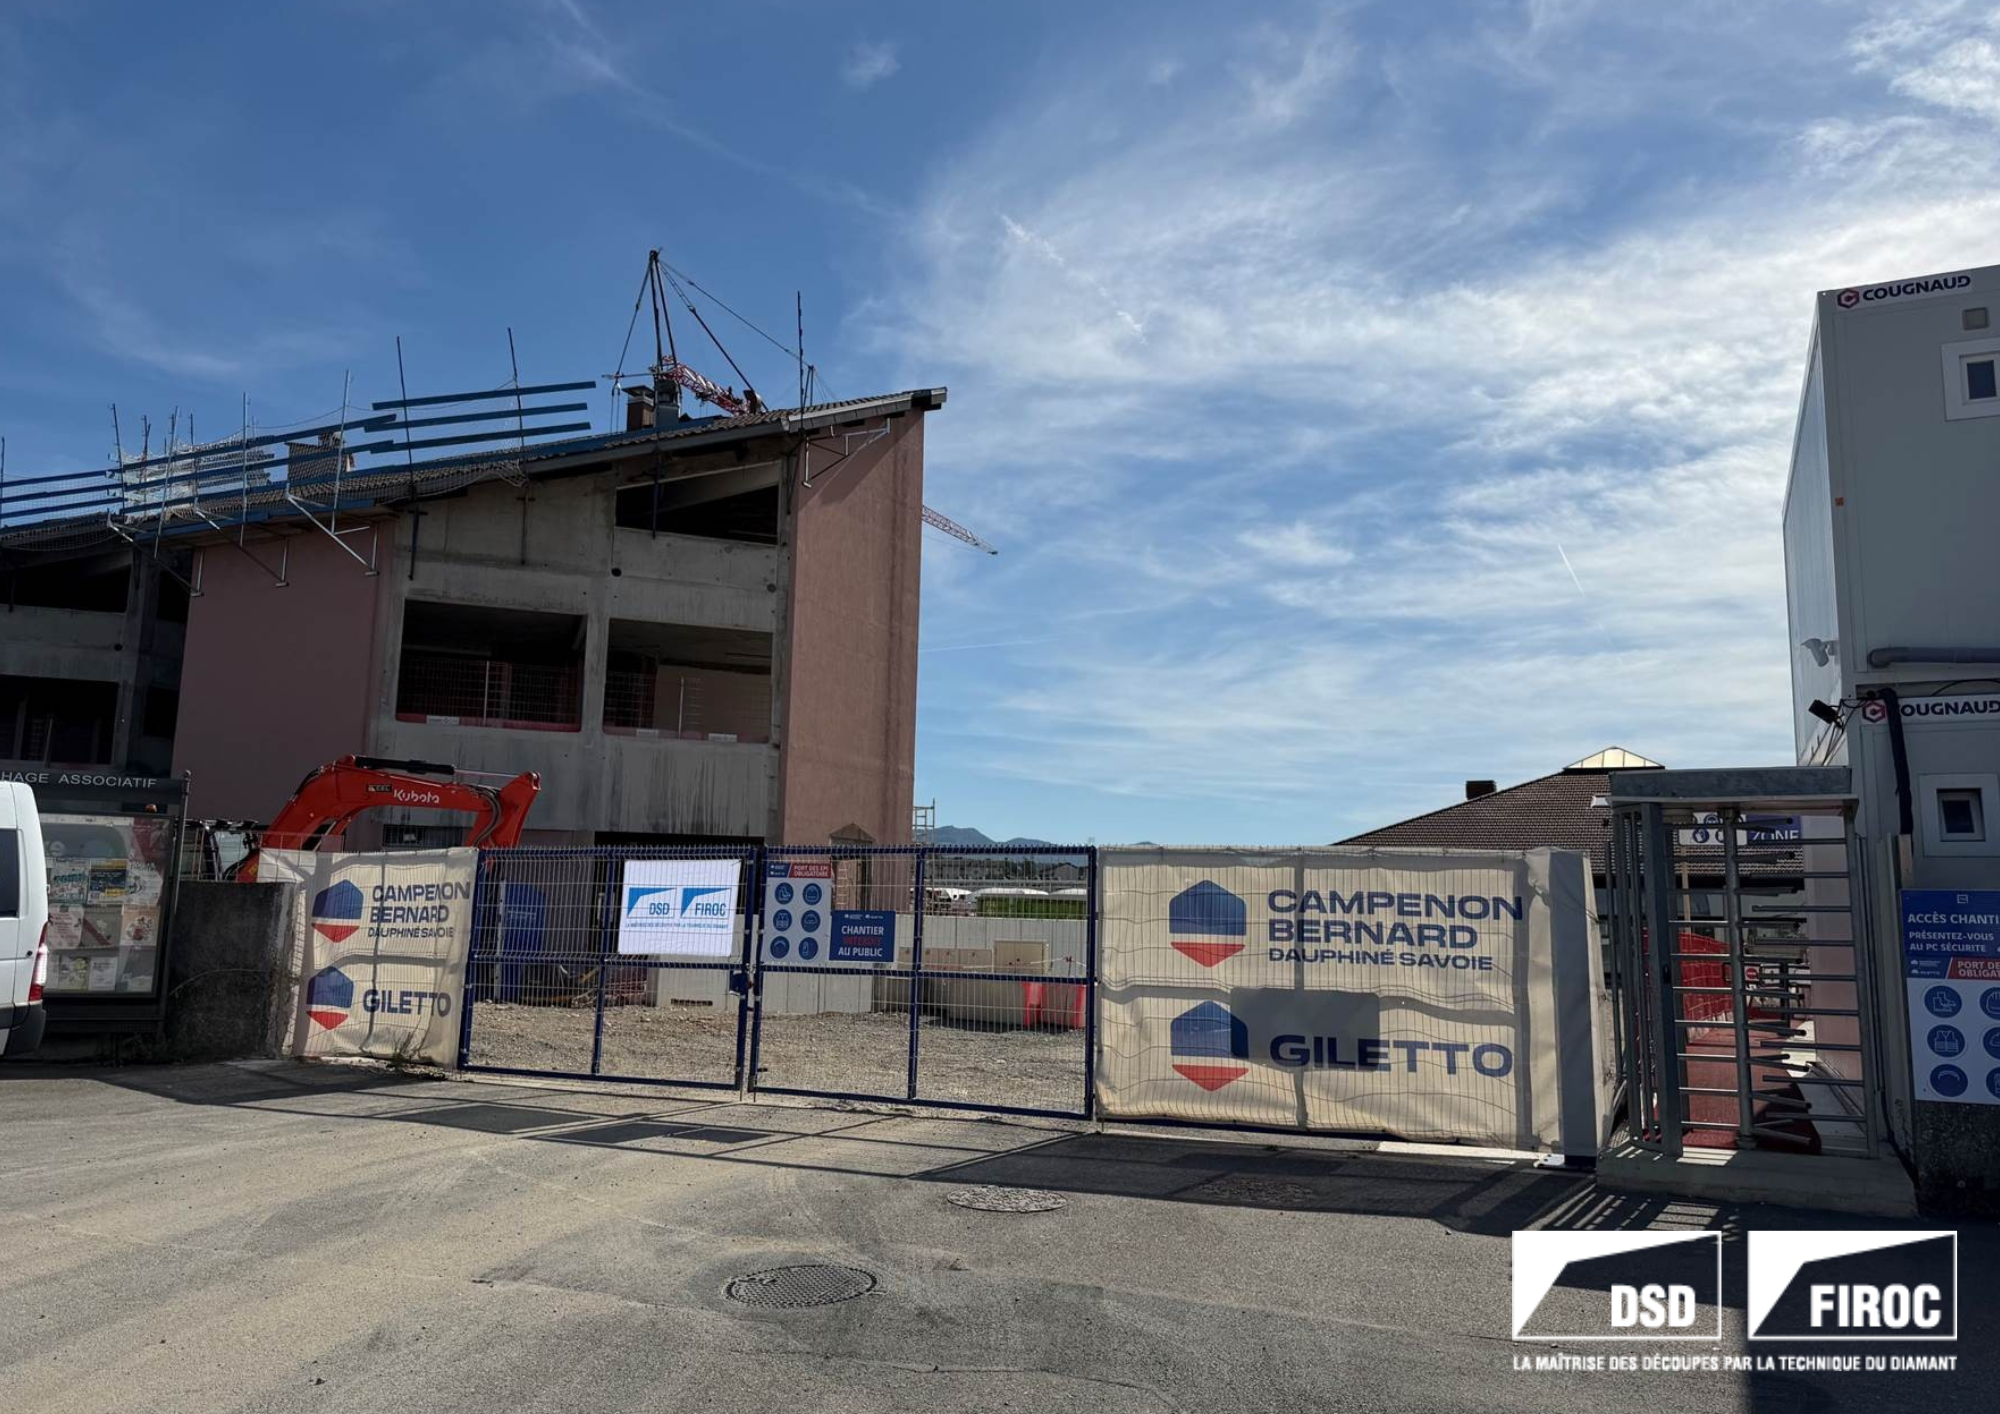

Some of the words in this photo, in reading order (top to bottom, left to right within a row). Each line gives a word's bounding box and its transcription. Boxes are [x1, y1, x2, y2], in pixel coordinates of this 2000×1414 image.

[1863, 275, 1971, 301] COUGNAUD
[1900, 700, 2000, 717] OUGNAUD
[58, 774, 157, 788] ASSOCIATIF
[393, 788, 440, 804] Kubota
[648, 902, 670, 916] DSD
[694, 902, 727, 917] FIROC
[1268, 889, 1523, 921] CAMPENON
[370, 904, 450, 923] BERNARD
[1908, 910, 1947, 924] ACCÈS
[367, 926, 420, 938] DAUPHINÉ
[841, 925, 884, 936] CHANTIER
[1268, 918, 1478, 949] BERNARD
[1909, 929, 1995, 941] PRÉSENTEZ-VOUS
[838, 946, 850, 956] AU
[852, 946, 883, 957] PUBLIC
[1909, 943, 1923, 951] AU
[1926, 943, 1938, 951] PC
[1268, 948, 1395, 966] DAUPHINÉ
[1399, 952, 1493, 971] SAVOIE
[1957, 961, 1984, 970] PORT
[363, 988, 451, 1017] GILETTO
[1270, 1034, 1513, 1078] GILETTO
